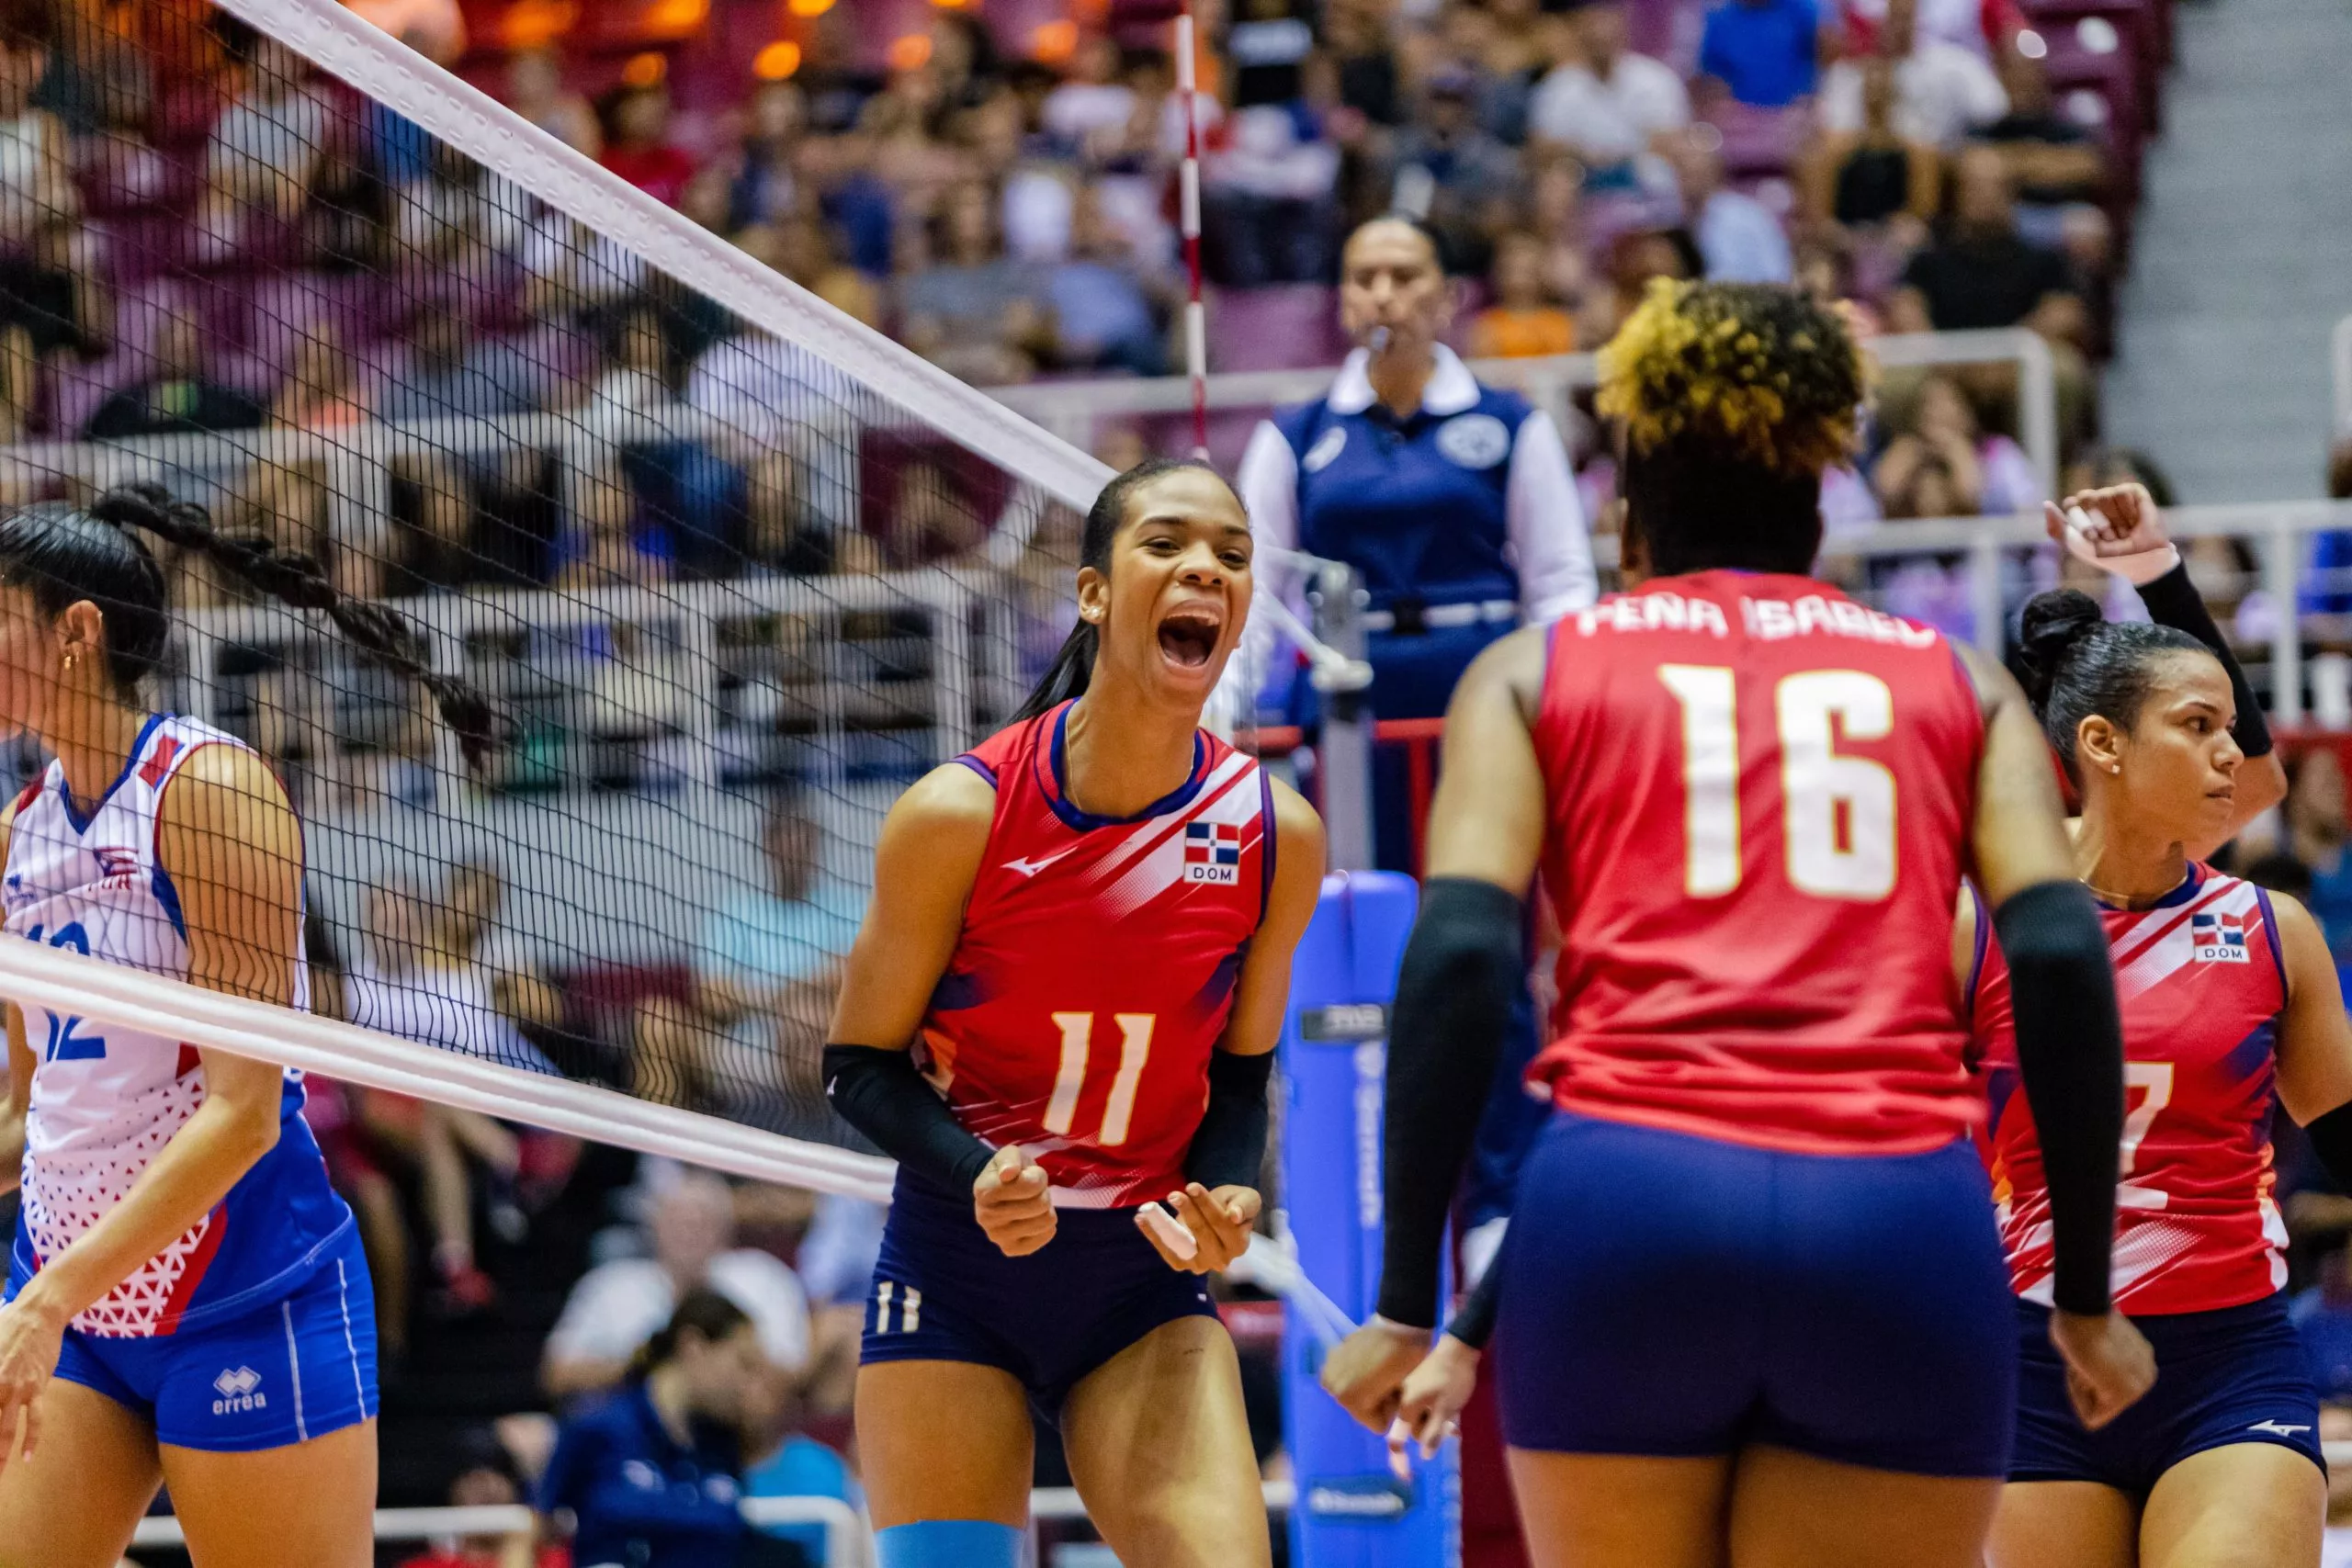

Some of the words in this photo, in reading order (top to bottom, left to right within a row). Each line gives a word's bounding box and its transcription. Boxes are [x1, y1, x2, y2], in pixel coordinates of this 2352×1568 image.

[1657, 663, 1899, 902] 16
[1193, 866, 1232, 882] DOM
[2205, 947, 2242, 960] DOM
[1042, 1011, 1156, 1145] 11
[876, 1280, 922, 1335] 11
